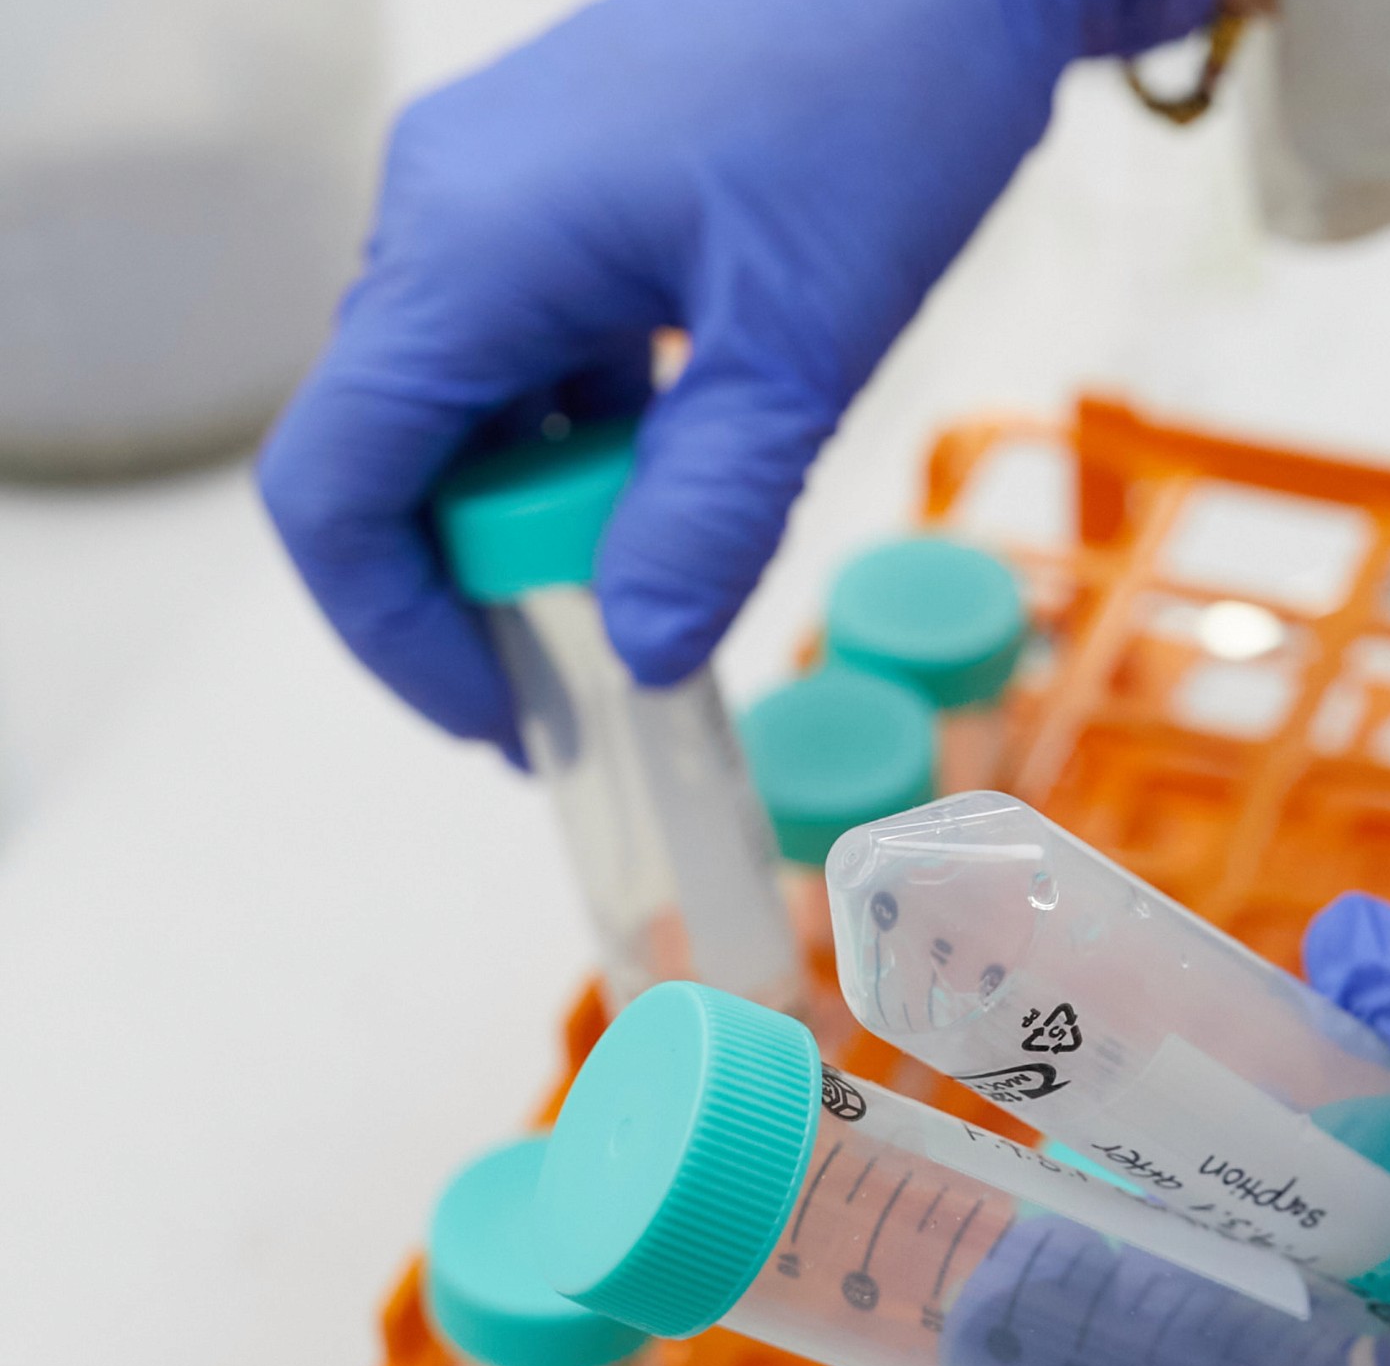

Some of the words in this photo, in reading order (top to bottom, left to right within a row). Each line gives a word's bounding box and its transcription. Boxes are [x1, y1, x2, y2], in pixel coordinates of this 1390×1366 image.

[1021, 1007, 1042, 1028] PP
[1048, 1025, 1067, 1041] 5
[1091, 1142, 1184, 1190] after
